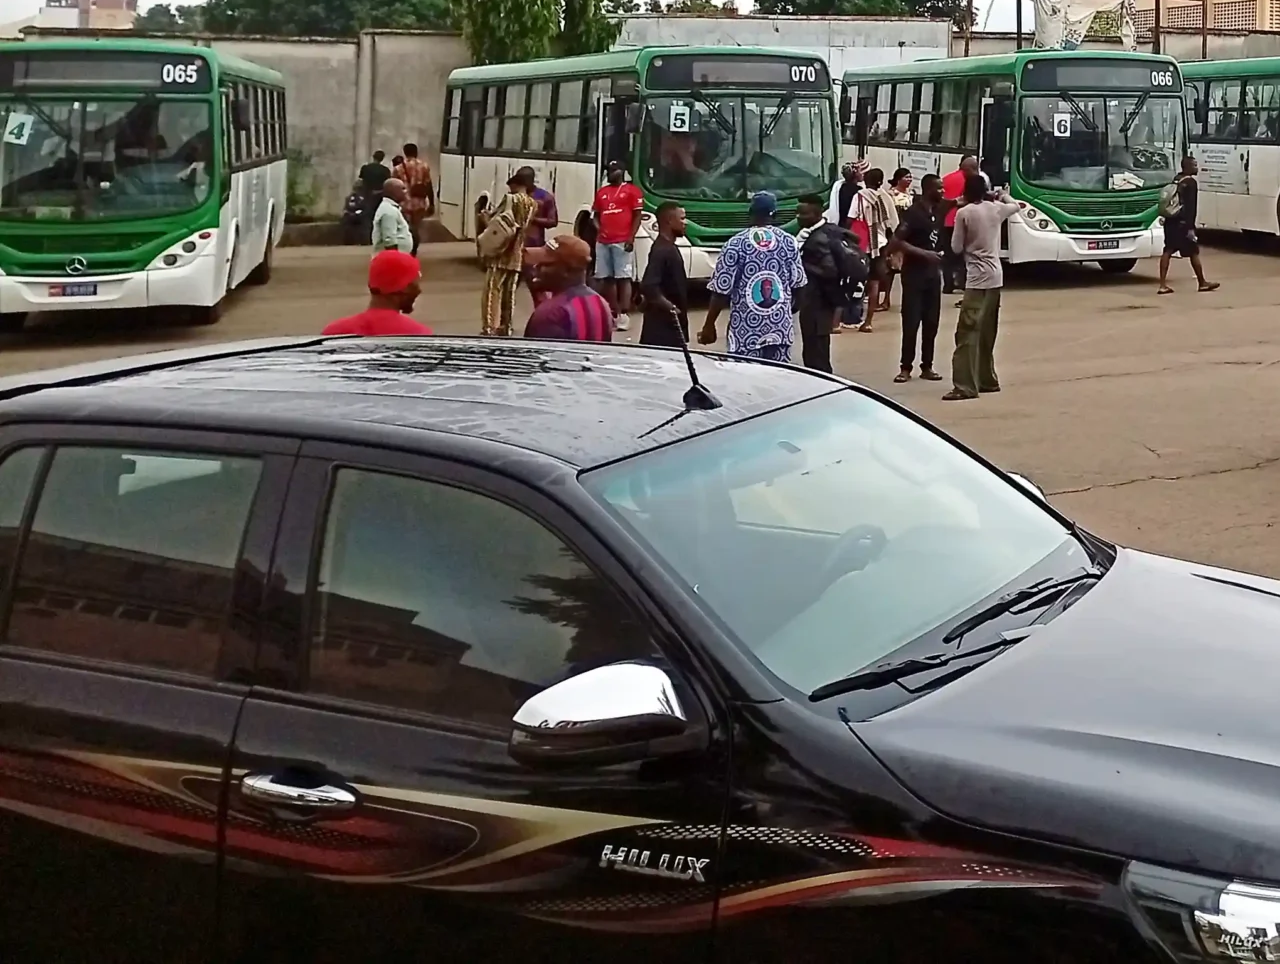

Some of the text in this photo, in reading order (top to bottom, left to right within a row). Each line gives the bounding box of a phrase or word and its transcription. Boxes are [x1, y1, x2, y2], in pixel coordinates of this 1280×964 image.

[162, 63, 197, 83] 065
[791, 65, 816, 82] 070
[1151, 71, 1173, 86] 066
[672, 112, 687, 129] 5
[1056, 119, 1069, 134] 6
[8, 121, 27, 140] 4
[599, 844, 710, 882] HILUX
